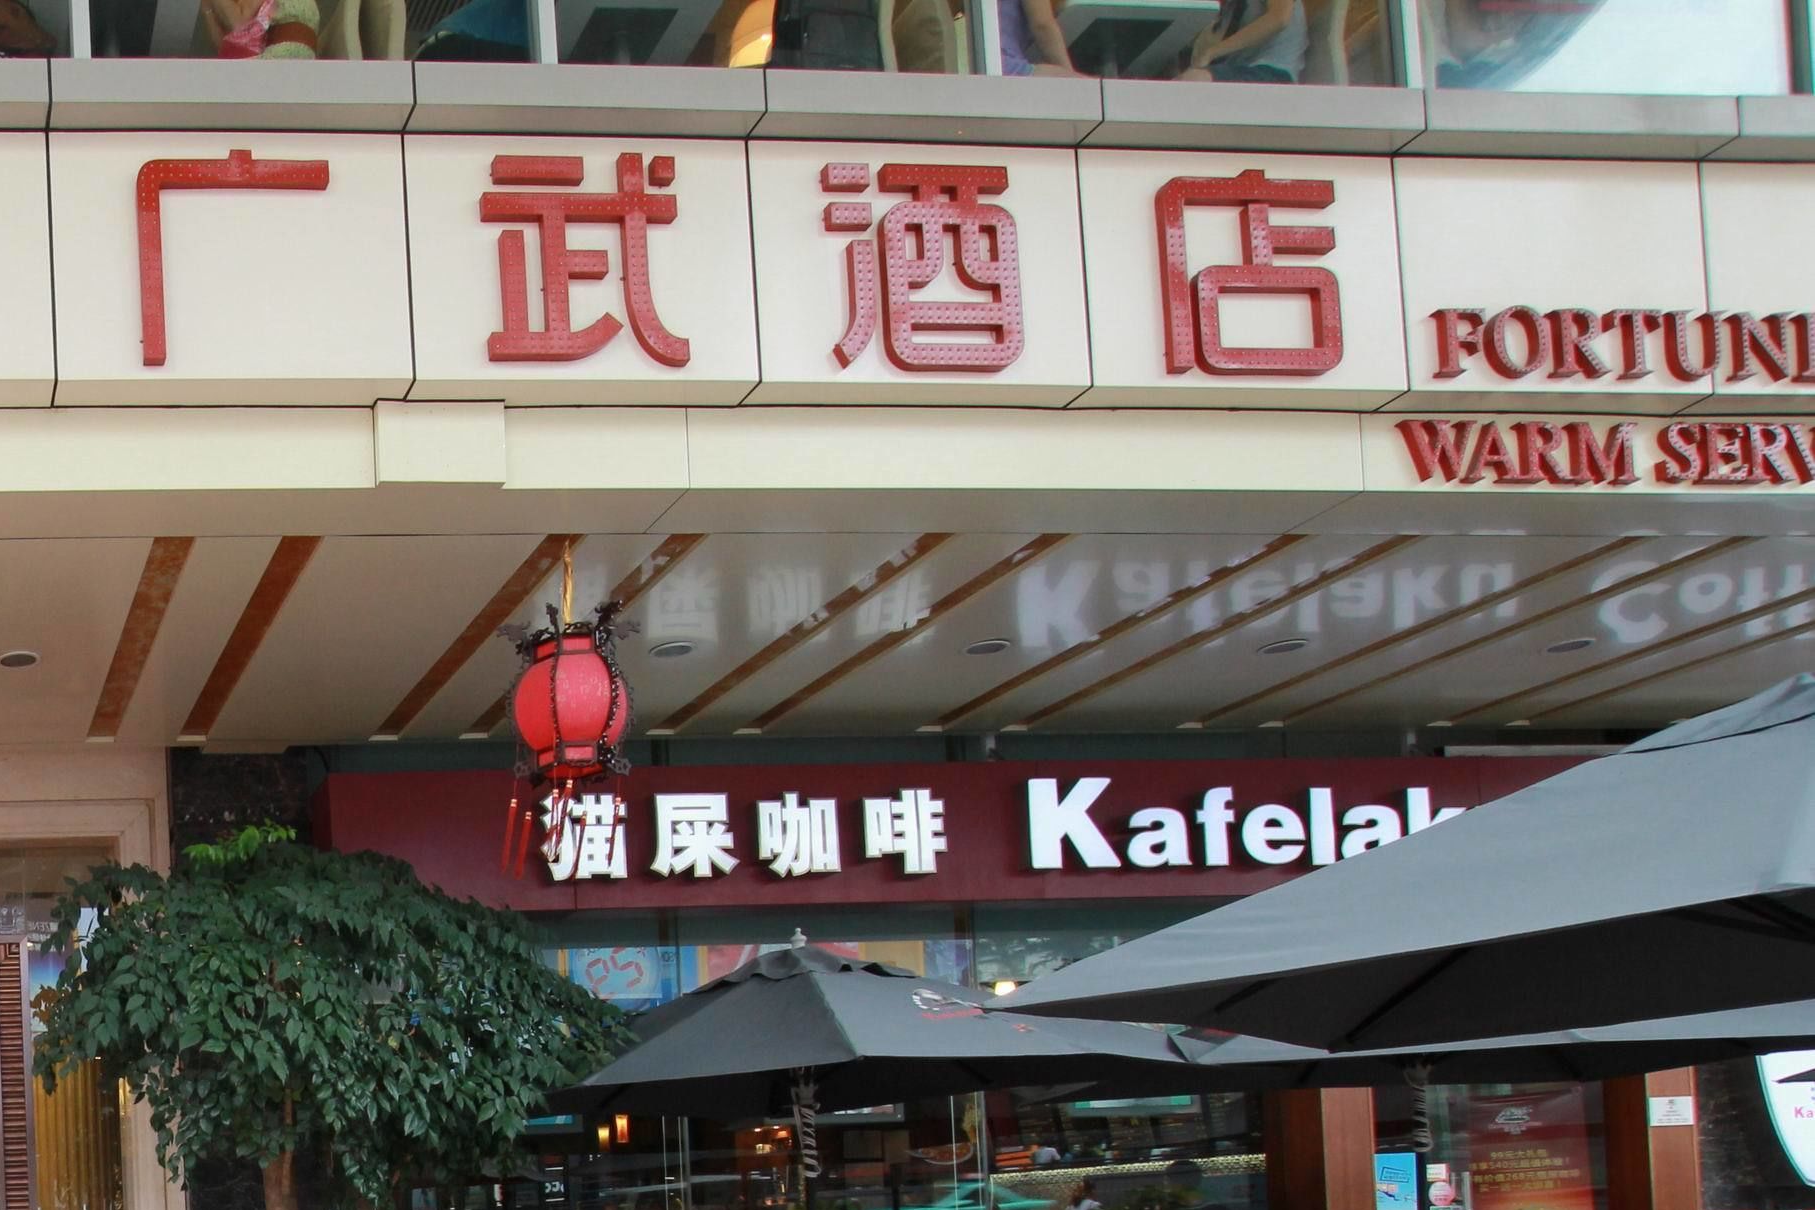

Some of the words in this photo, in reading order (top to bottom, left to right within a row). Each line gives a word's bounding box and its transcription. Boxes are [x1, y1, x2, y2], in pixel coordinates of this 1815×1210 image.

[1395, 420, 1641, 487] WARM
[539, 788, 948, 881] 猫屎咖啡
